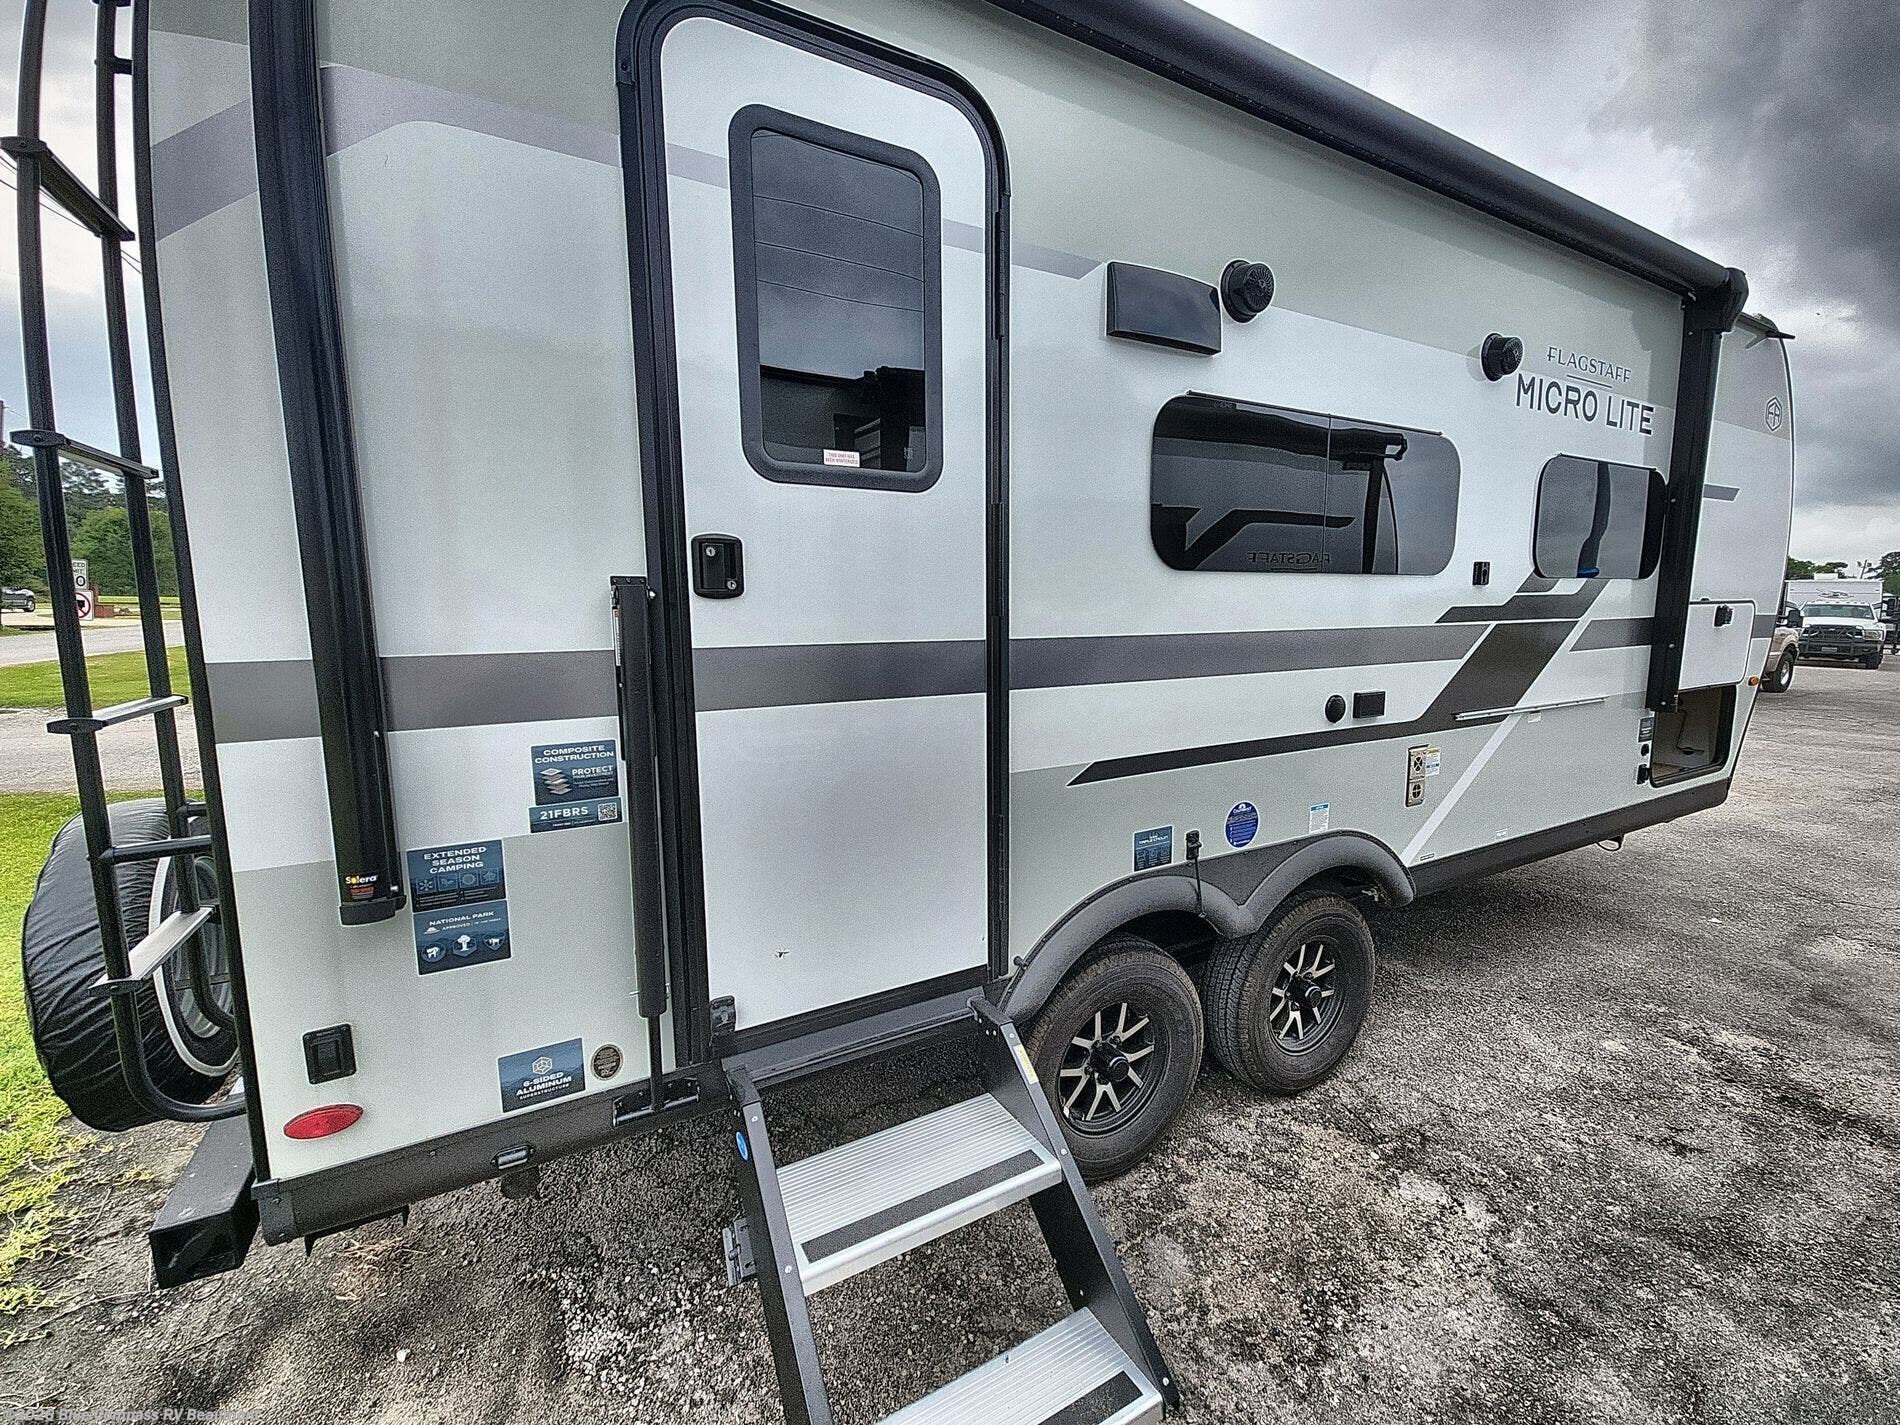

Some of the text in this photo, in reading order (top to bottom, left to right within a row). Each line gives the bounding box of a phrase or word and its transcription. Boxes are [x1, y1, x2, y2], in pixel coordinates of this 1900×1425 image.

[1547, 346, 1632, 383] FLAGSTAFF
[1516, 373, 1655, 435] MICRO LITE
[543, 744, 605, 756] COMPOSITE
[534, 751, 615, 764] CONSTRUCTION
[572, 765, 613, 775] PROTECT
[540, 806, 589, 820] 21FBRS
[423, 846, 487, 861] EXTENDED
[432, 854, 480, 867] SEASON
[429, 861, 484, 874] CAMPING
[345, 874, 379, 885] Solera
[429, 915, 471, 926] NATIONAL
[523, 1071, 564, 1087] 6-SIDED
[516, 1076, 572, 1096] ALUMINUM
[519, 1083, 570, 1099] SUPERSTRUCTURE
